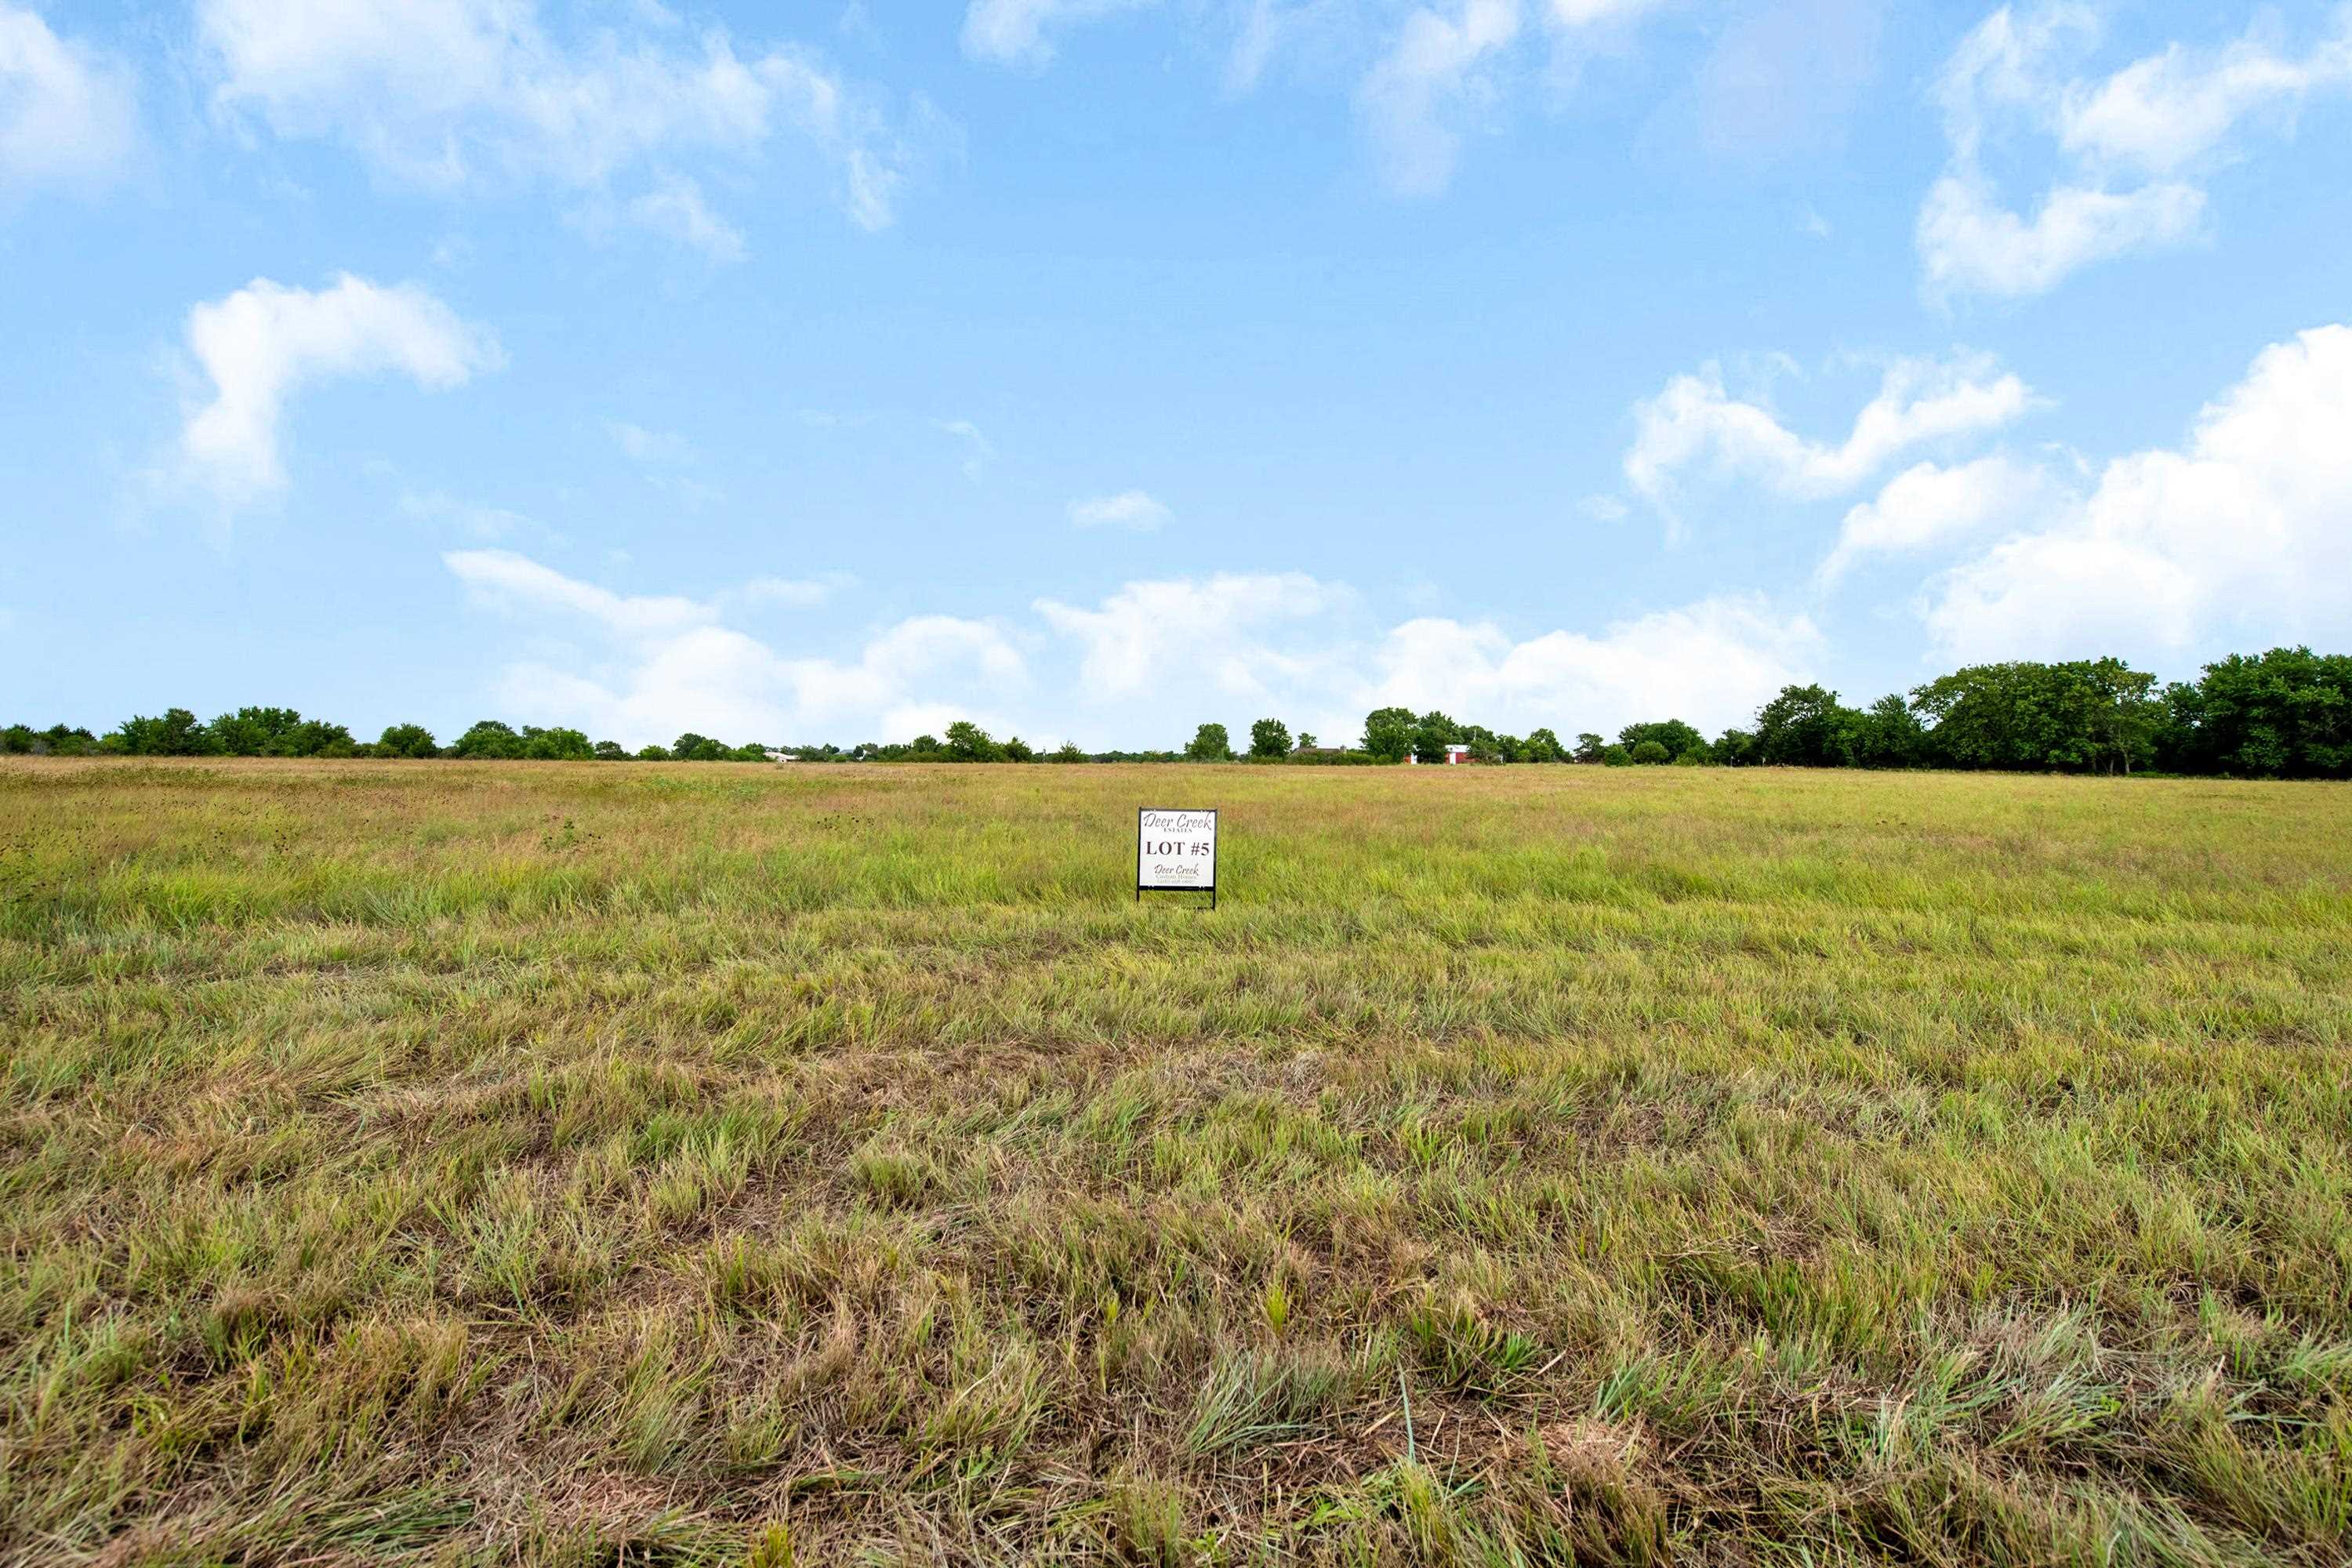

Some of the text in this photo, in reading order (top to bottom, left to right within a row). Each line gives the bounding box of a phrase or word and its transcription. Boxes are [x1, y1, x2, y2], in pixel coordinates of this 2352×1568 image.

[1143, 811, 1212, 830] Deer Creek
[1146, 841, 1210, 855] LOT #5
[1154, 863, 1199, 876] Deer Creek
